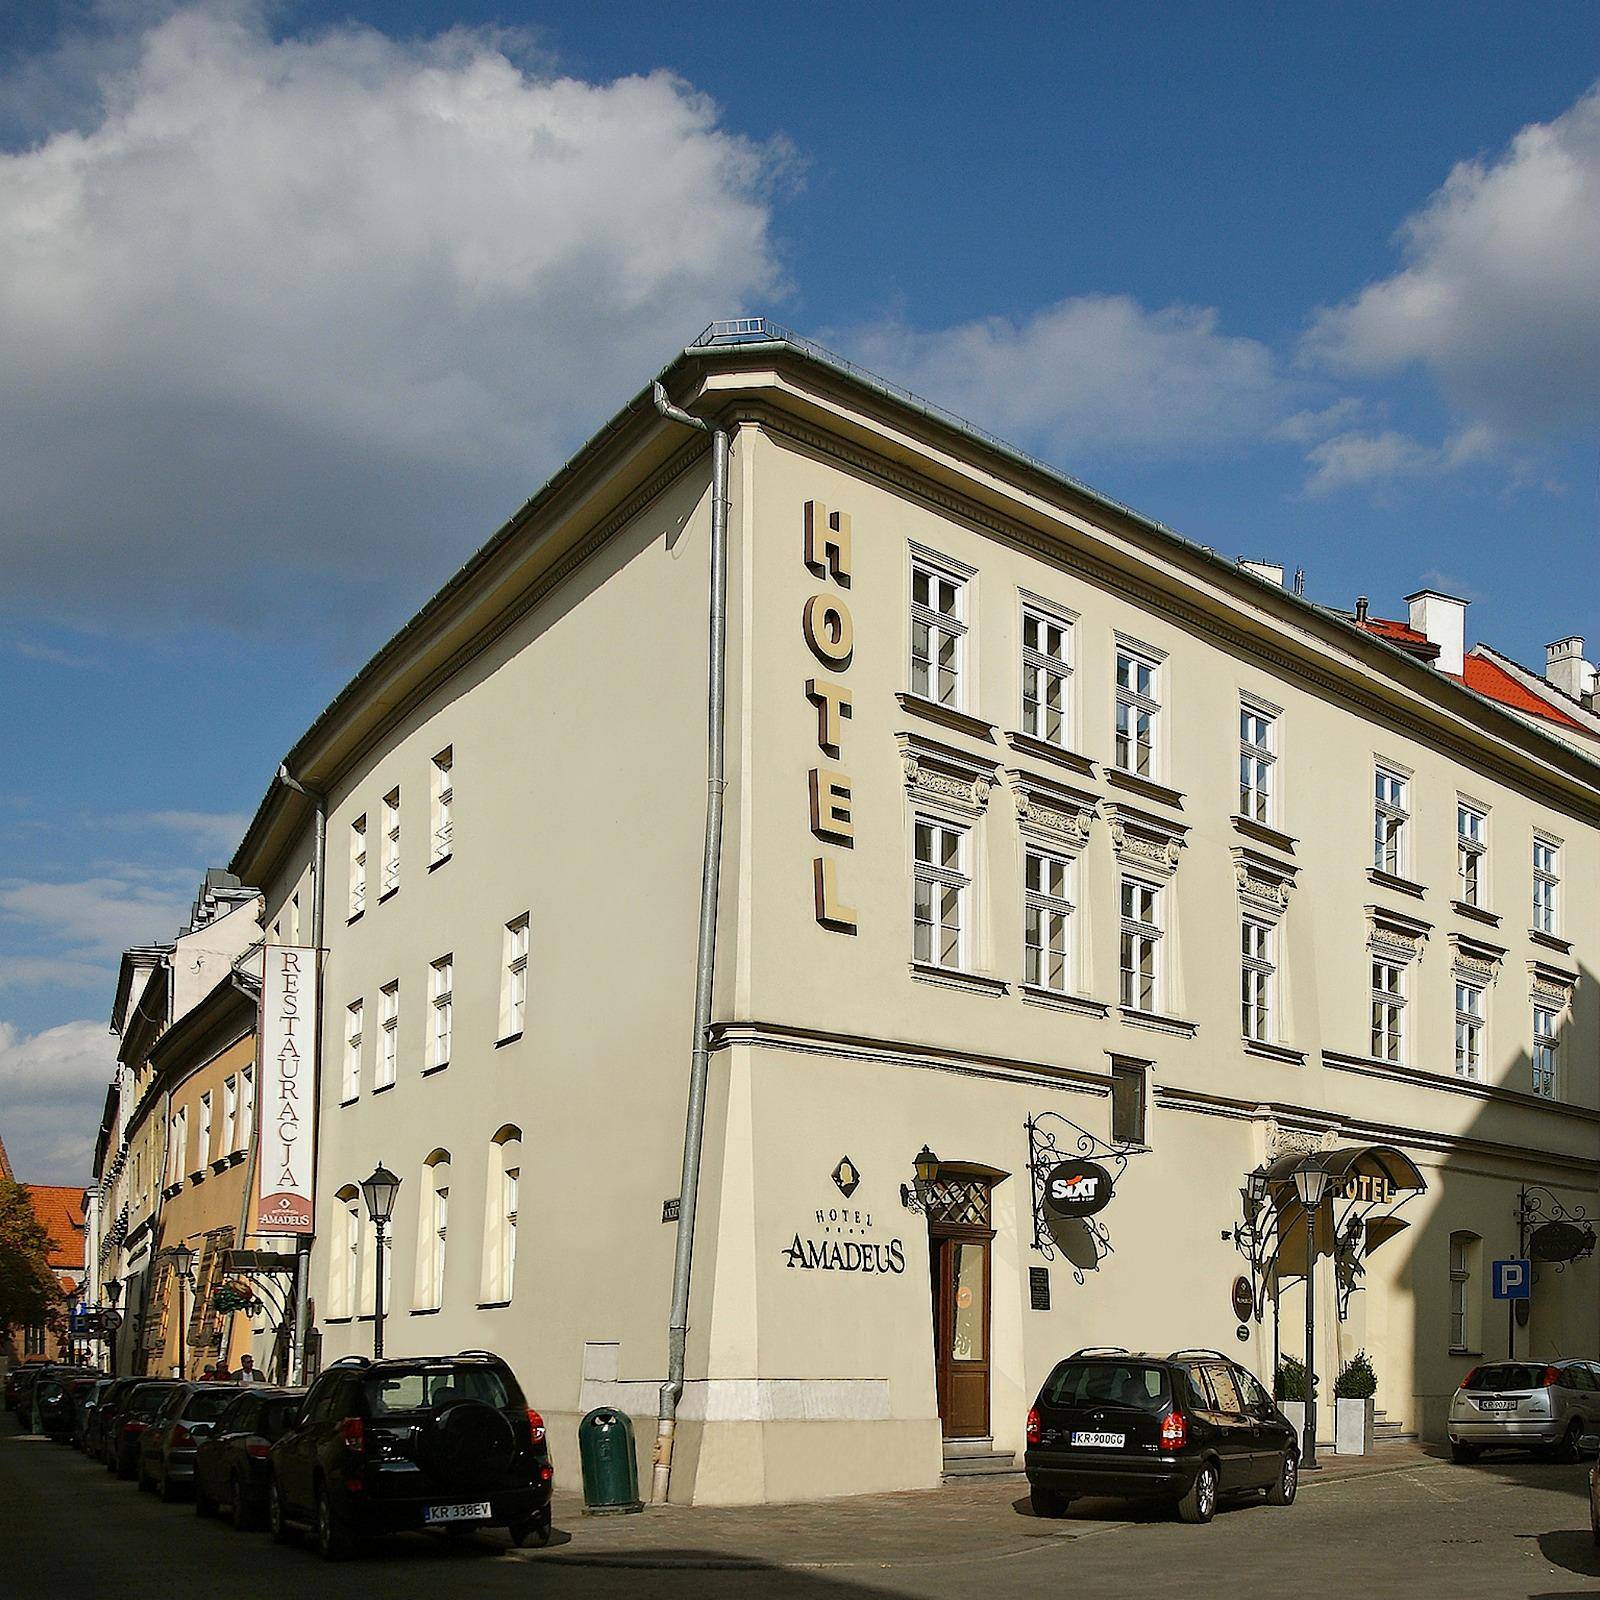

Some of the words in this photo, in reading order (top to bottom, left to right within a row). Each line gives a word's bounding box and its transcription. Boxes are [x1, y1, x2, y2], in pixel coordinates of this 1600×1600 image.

[804, 499, 857, 936] HOTEL
[277, 951, 301, 1187] RESTAURACJA
[816, 1208, 872, 1226] HOTEL
[782, 1232, 905, 1274] AMADEUS
[1501, 1264, 1522, 1294] P
[1076, 1433, 1091, 1443] KR
[431, 1507, 449, 1518] KR
[453, 1503, 488, 1516] 338EV
